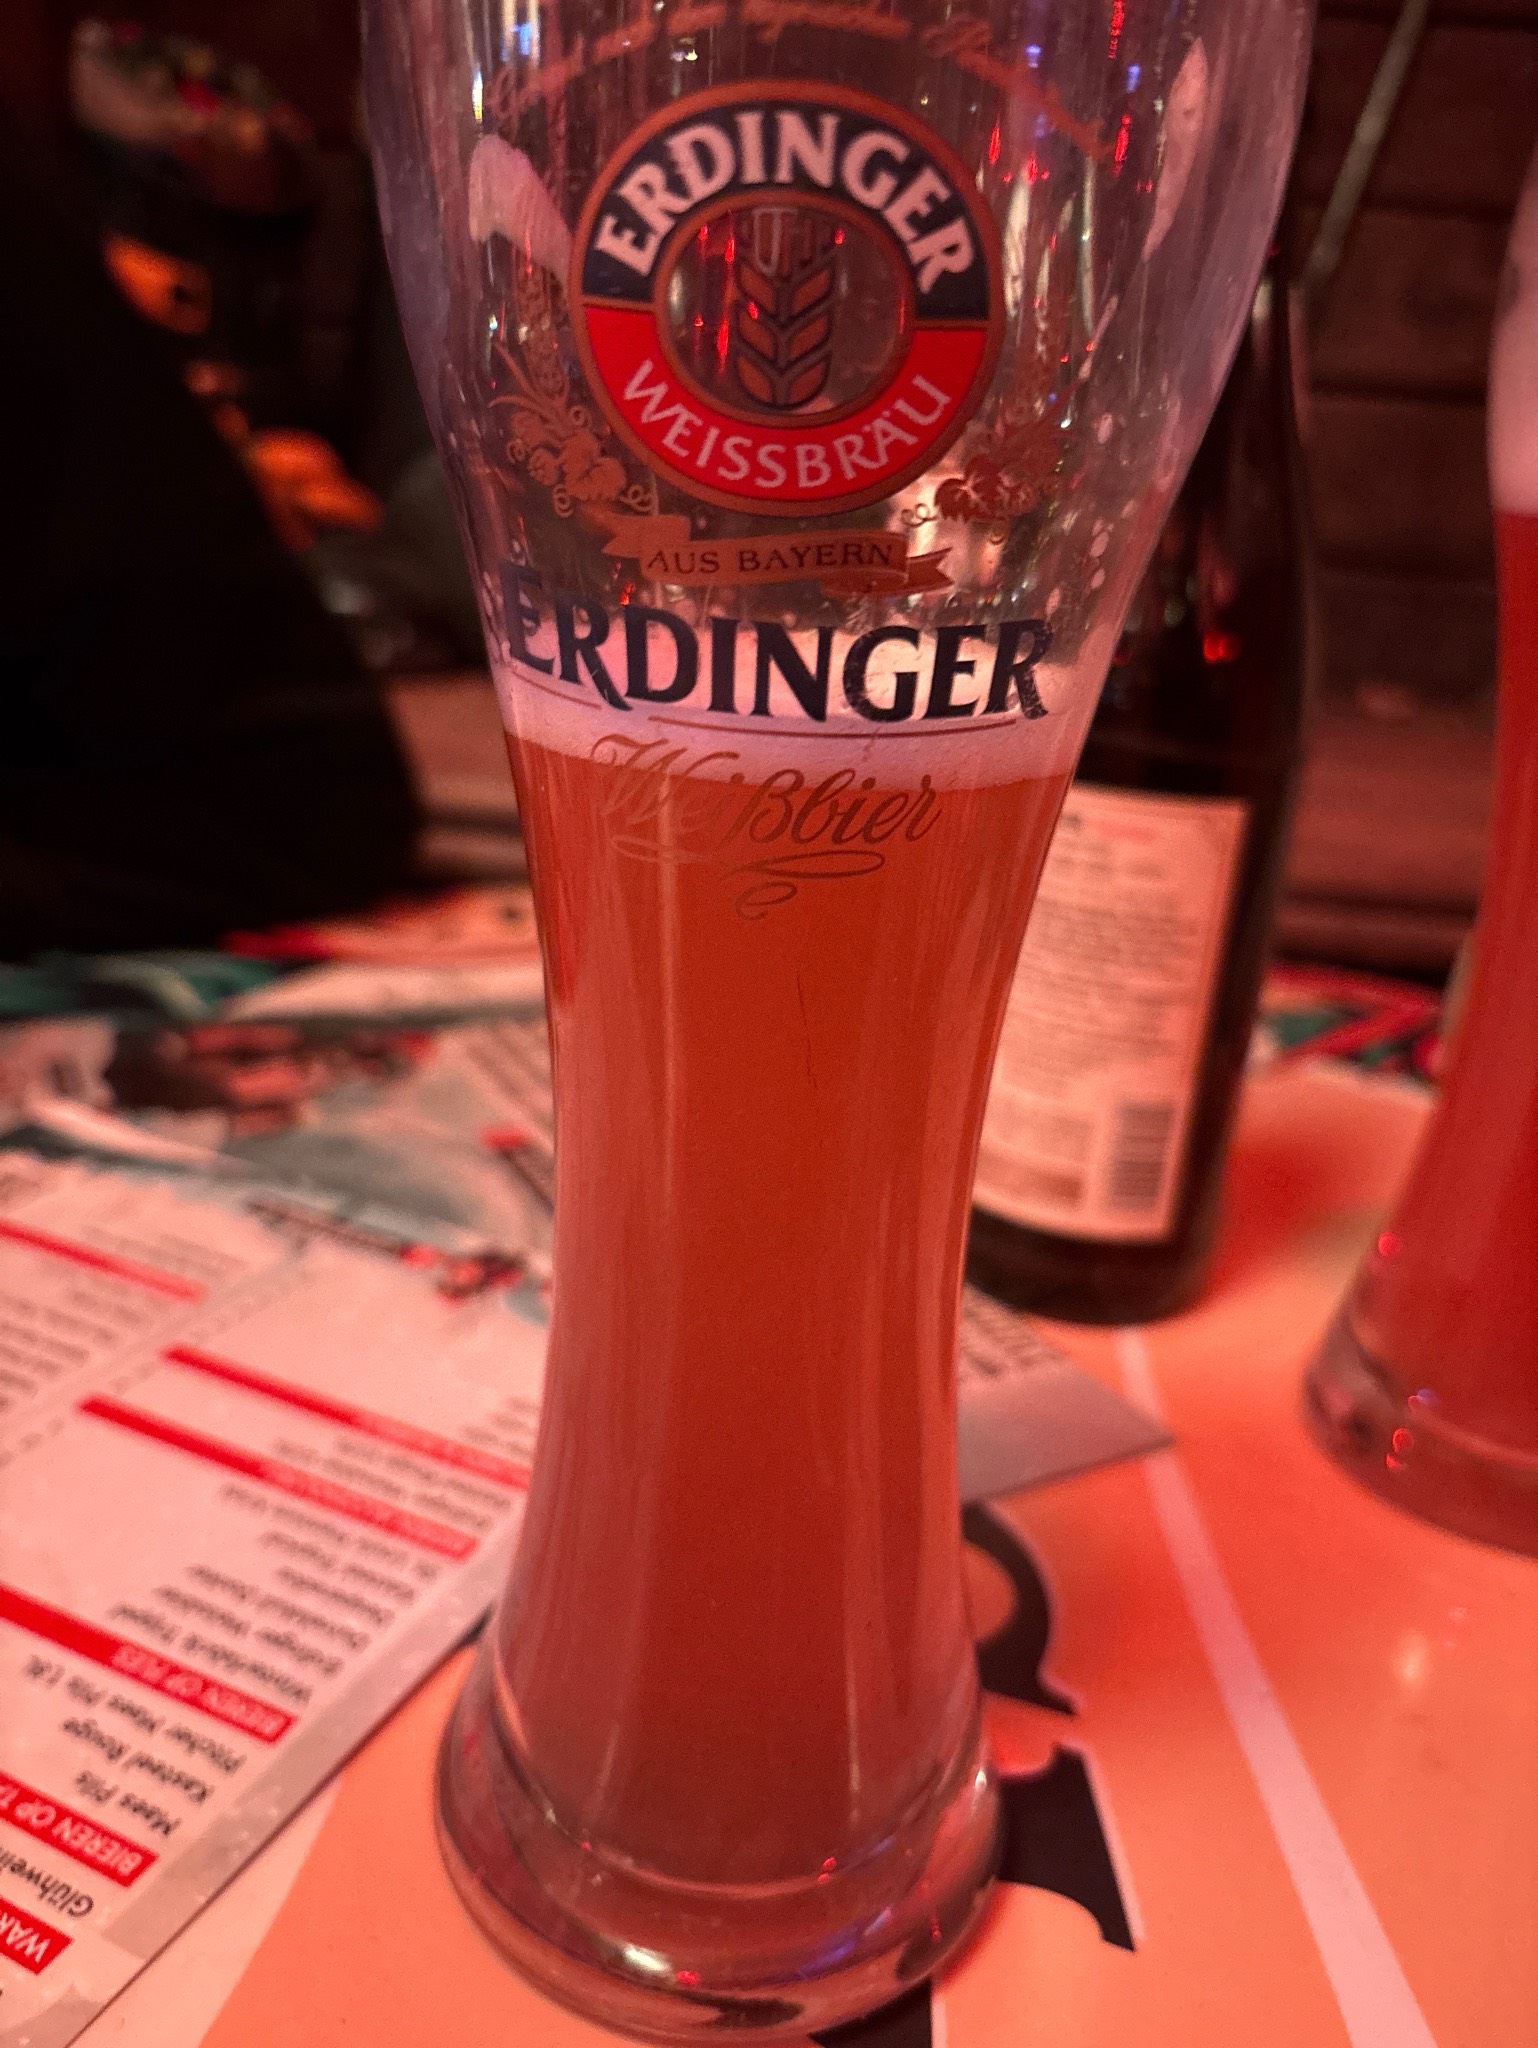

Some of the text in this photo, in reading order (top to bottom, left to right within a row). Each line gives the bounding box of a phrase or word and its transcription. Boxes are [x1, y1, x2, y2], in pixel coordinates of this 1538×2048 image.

[594, 109, 974, 294] ERDINGER
[622, 359, 952, 489] WEISSBRÄU
[647, 542, 894, 576] AUS BAYERN
[503, 561, 1054, 724] ERDINGER
[61, 1717, 131, 1763] Rouge
[14, 1799, 57, 1828] OP
[75, 1769, 182, 1837] Maes Pils
[51, 1815, 143, 1876] BIEREN
